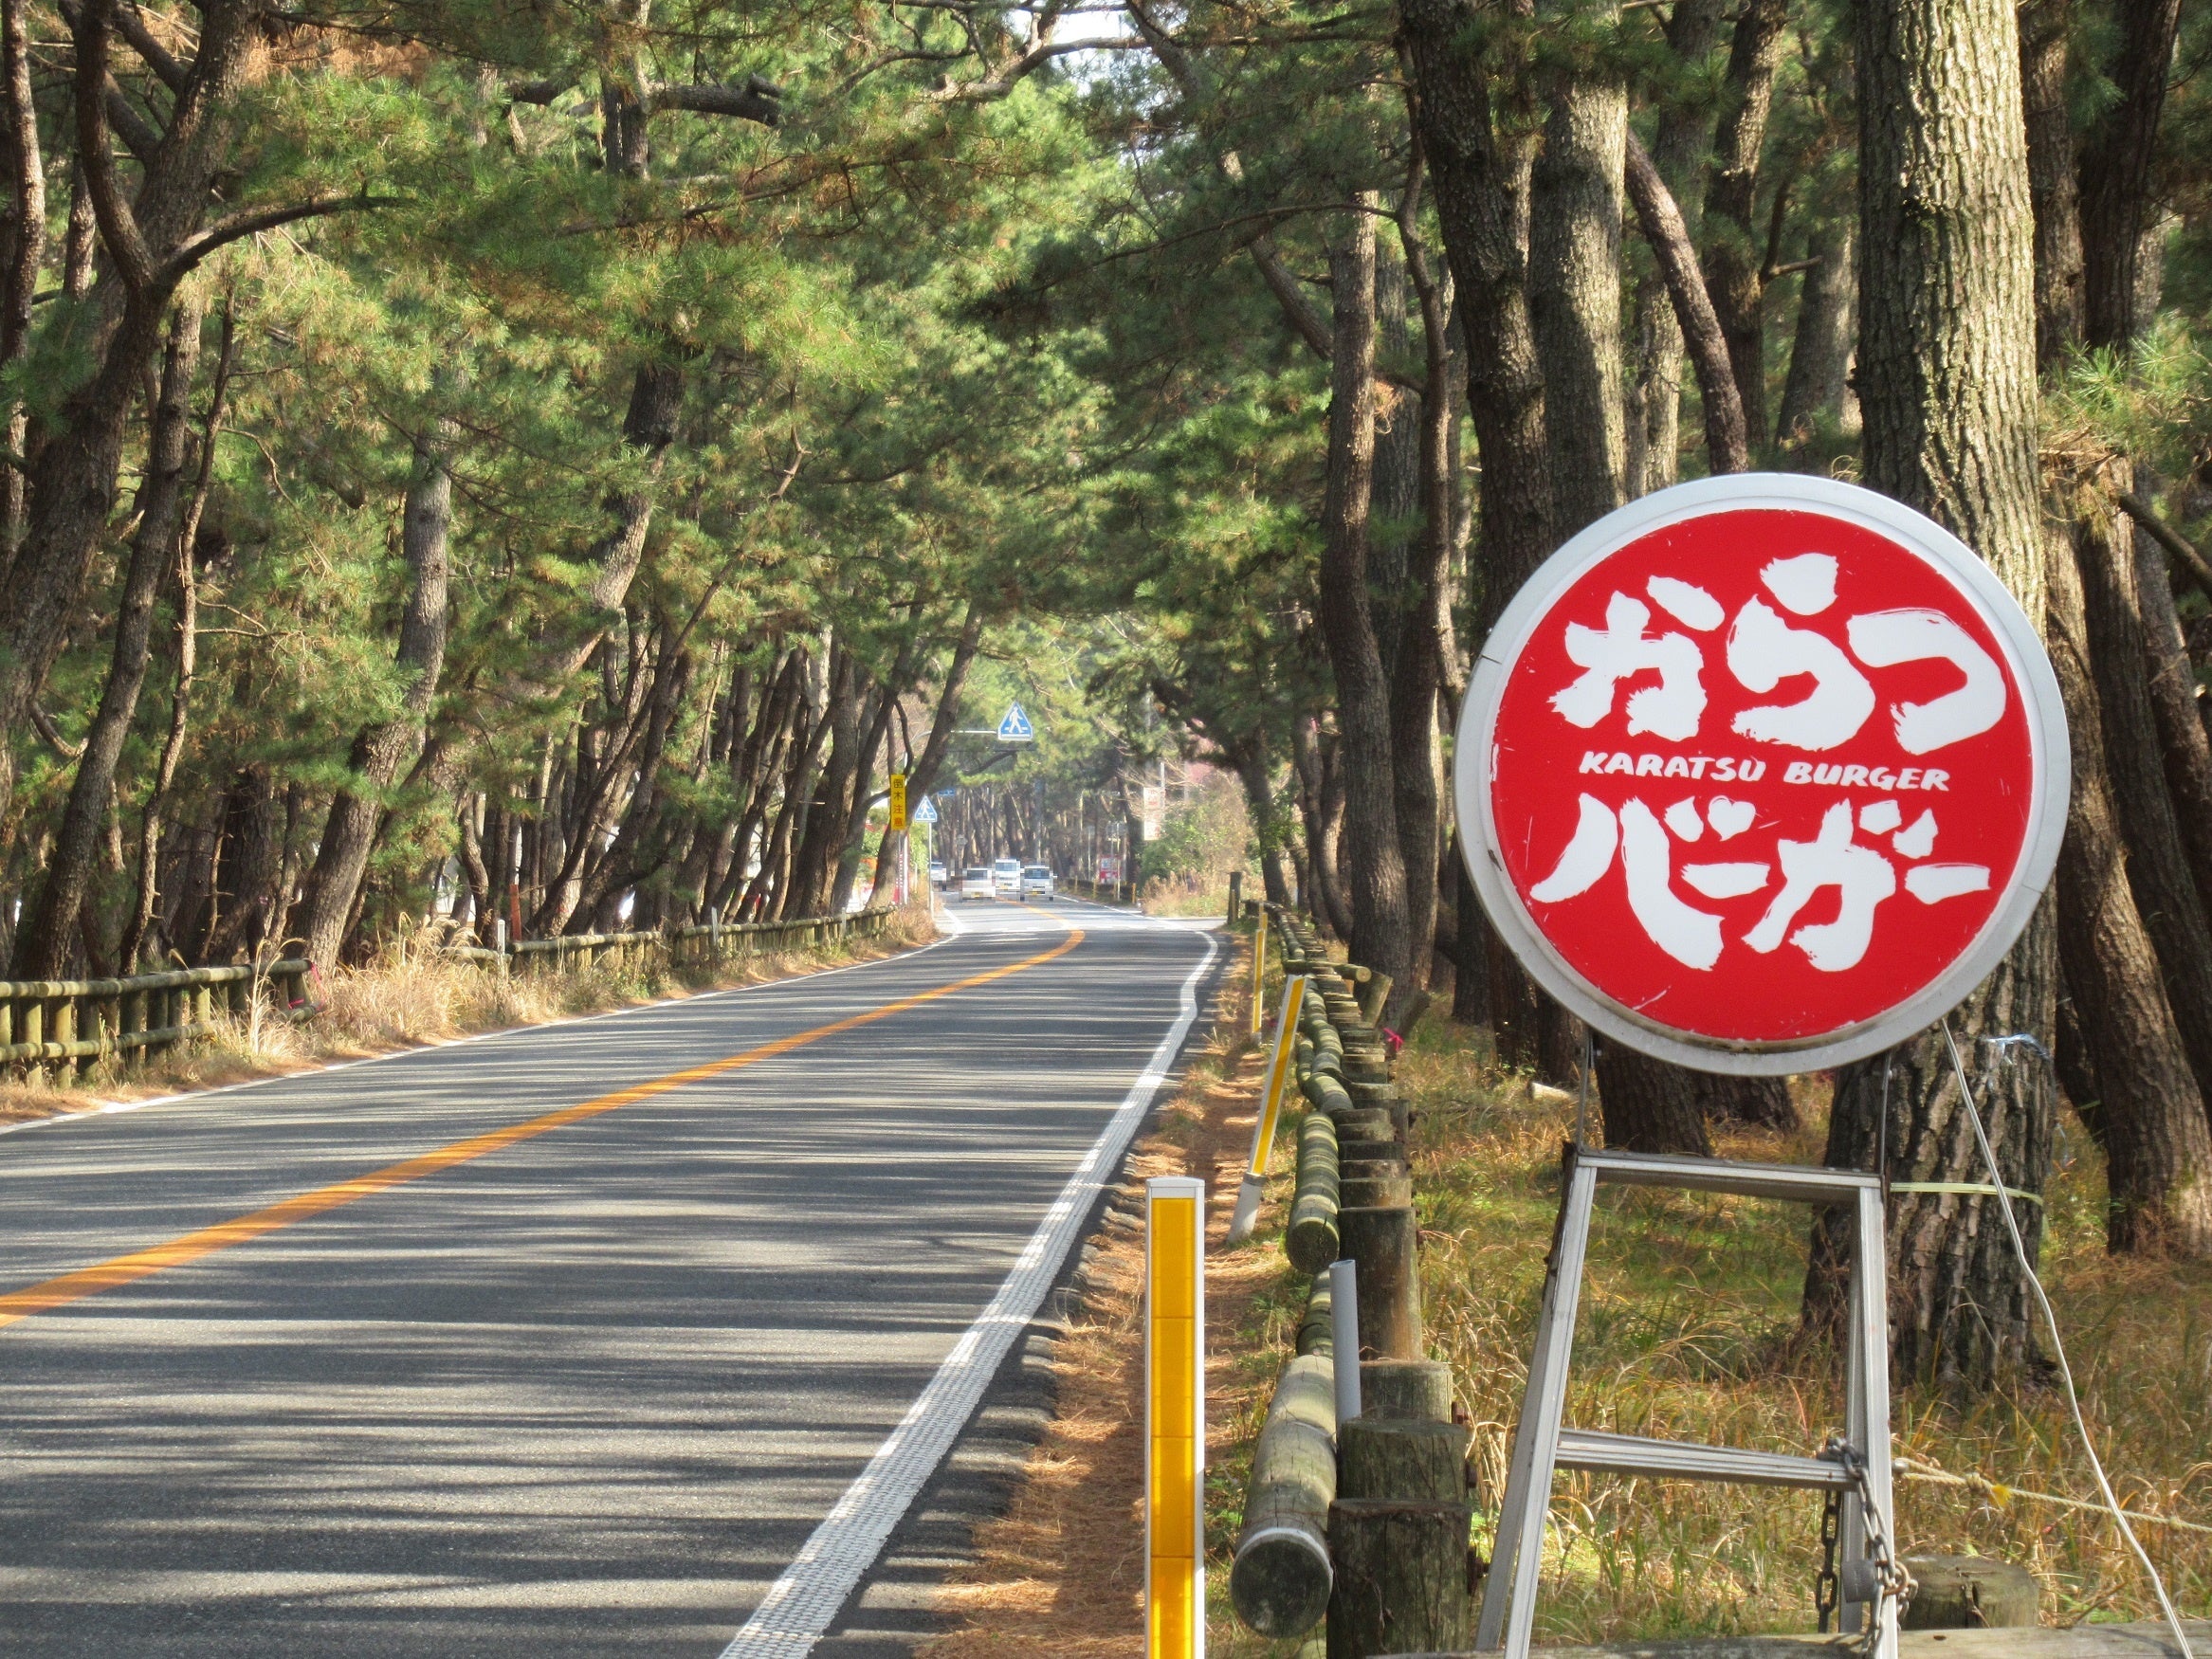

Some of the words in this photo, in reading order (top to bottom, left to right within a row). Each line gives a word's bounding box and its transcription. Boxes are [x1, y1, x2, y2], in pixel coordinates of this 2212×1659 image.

[1546, 553, 2007, 756] からつ
[893, 778, 904, 827] 倒木注意
[1579, 751, 1766, 782] KARATSU
[1783, 761, 1950, 792] BURGER
[1529, 792, 1991, 973] バーガー
